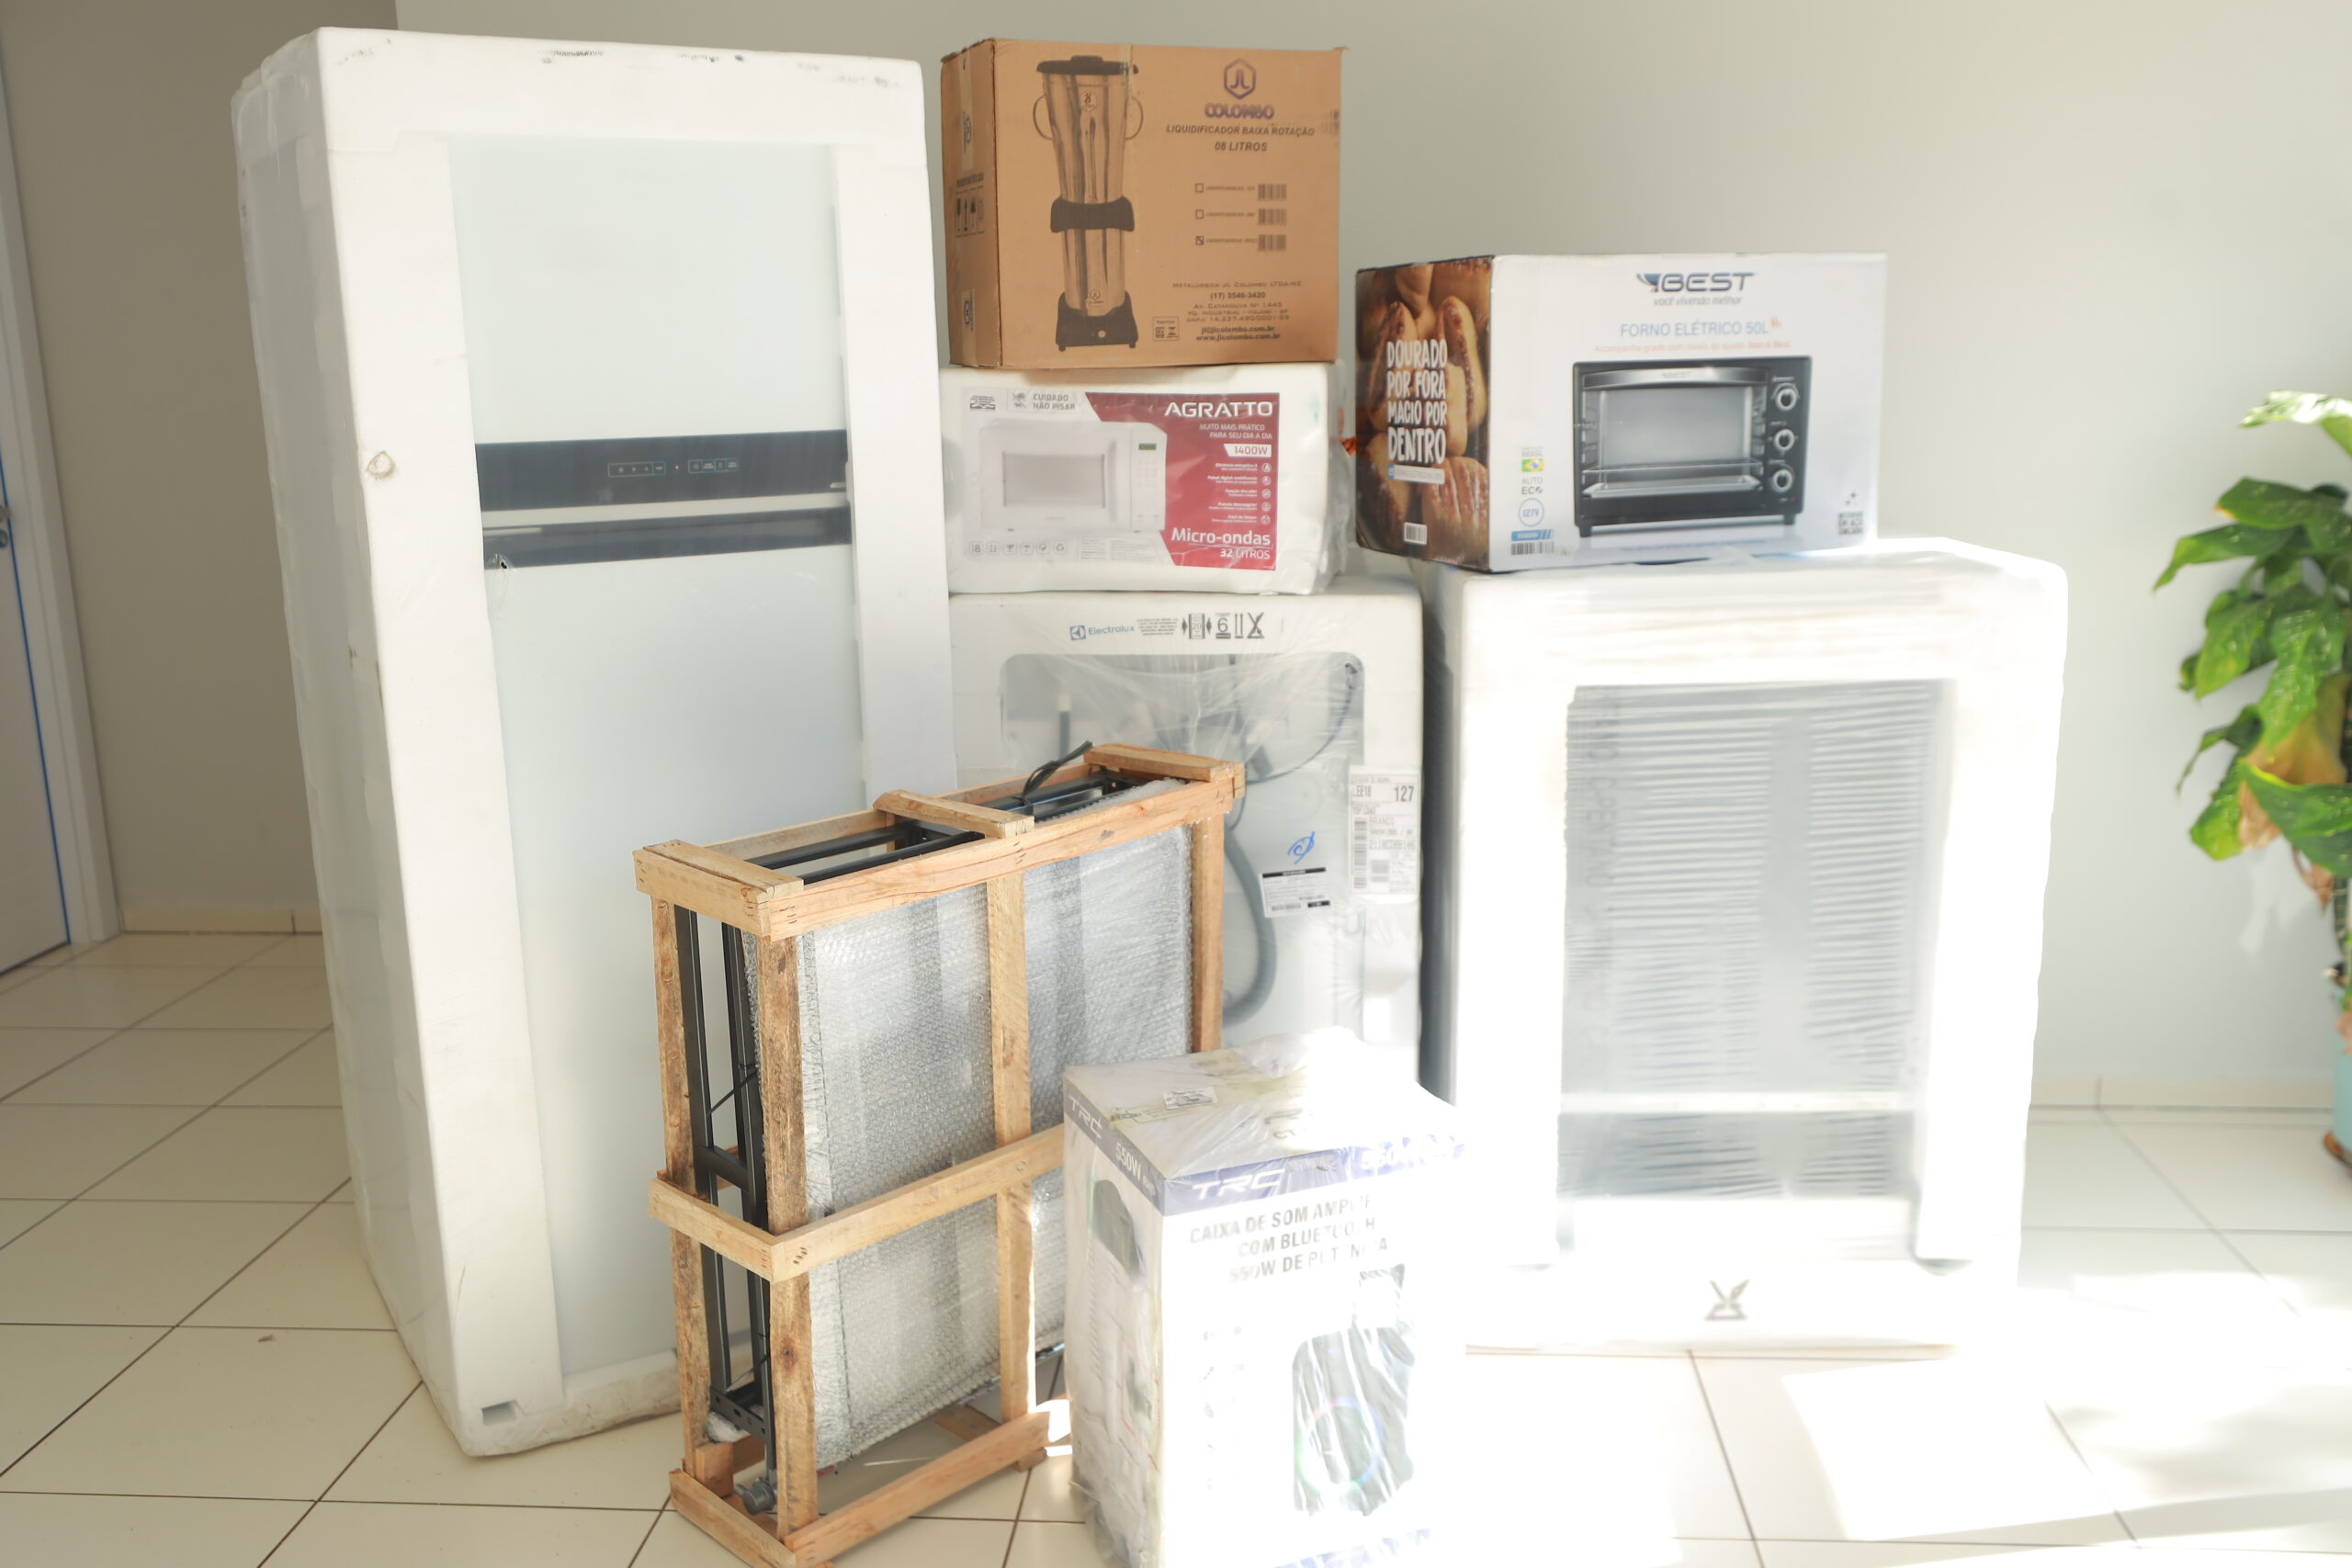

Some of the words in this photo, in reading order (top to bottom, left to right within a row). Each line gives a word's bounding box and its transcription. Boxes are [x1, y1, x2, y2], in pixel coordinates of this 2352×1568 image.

[1204, 103, 1275, 119] COLOMBO
[1166, 125, 1240, 135] LIQUIDIFICADOR
[1241, 127, 1270, 135] BAIXA
[1272, 127, 1316, 138] ROTAÇÃO
[1215, 141, 1227, 151] 08
[1228, 141, 1268, 152] LITROS
[1661, 272, 1755, 293] BEST
[1210, 292, 1226, 300] (17)
[1654, 296, 1674, 306] você
[1676, 295, 1711, 306] vivendo
[1712, 295, 1742, 306] melhor
[1620, 322, 1671, 338] FORNO
[1674, 319, 1743, 337] ELÉTRICO
[1746, 321, 1770, 335] 50L
[1386, 338, 1448, 369] DOURADO
[1386, 369, 1412, 399] POR
[1415, 369, 1447, 400] FORA
[1033, 393, 1069, 401] CUIDADO
[1033, 400, 1050, 410] NÃO
[1052, 402, 1076, 411] PISAR
[1164, 400, 1273, 418] AGRATTO
[1387, 400, 1423, 425] MACIO
[1425, 400, 1448, 426] POR
[1209, 431, 1227, 439] PARA
[1261, 432, 1272, 440] DIA
[1238, 423, 1265, 431] PRÁTICO
[1234, 446, 1268, 456] 1400W
[1387, 426, 1448, 465] DENTRO
[1521, 476, 1544, 485] AUTO
[1522, 508, 1540, 518] 127V
[1171, 527, 1272, 546] Micro-ondas
[1219, 548, 1233, 558] 32
[1235, 549, 1271, 559] LITROS
[1088, 624, 1136, 636] Electrolux
[1217, 616, 1228, 633] 6
[1394, 784, 1415, 802] 127
[1067, 1094, 1102, 1140] TRC
[1115, 1140, 1141, 1181] 550W
[1191, 1168, 1287, 1201] TRC
[1189, 1221, 1240, 1245] CAIXA
[1245, 1213, 1266, 1234] DE
[1271, 1205, 1309, 1229] SOM
[1238, 1235, 1276, 1258] COM
[1282, 1254, 1304, 1273] DE
